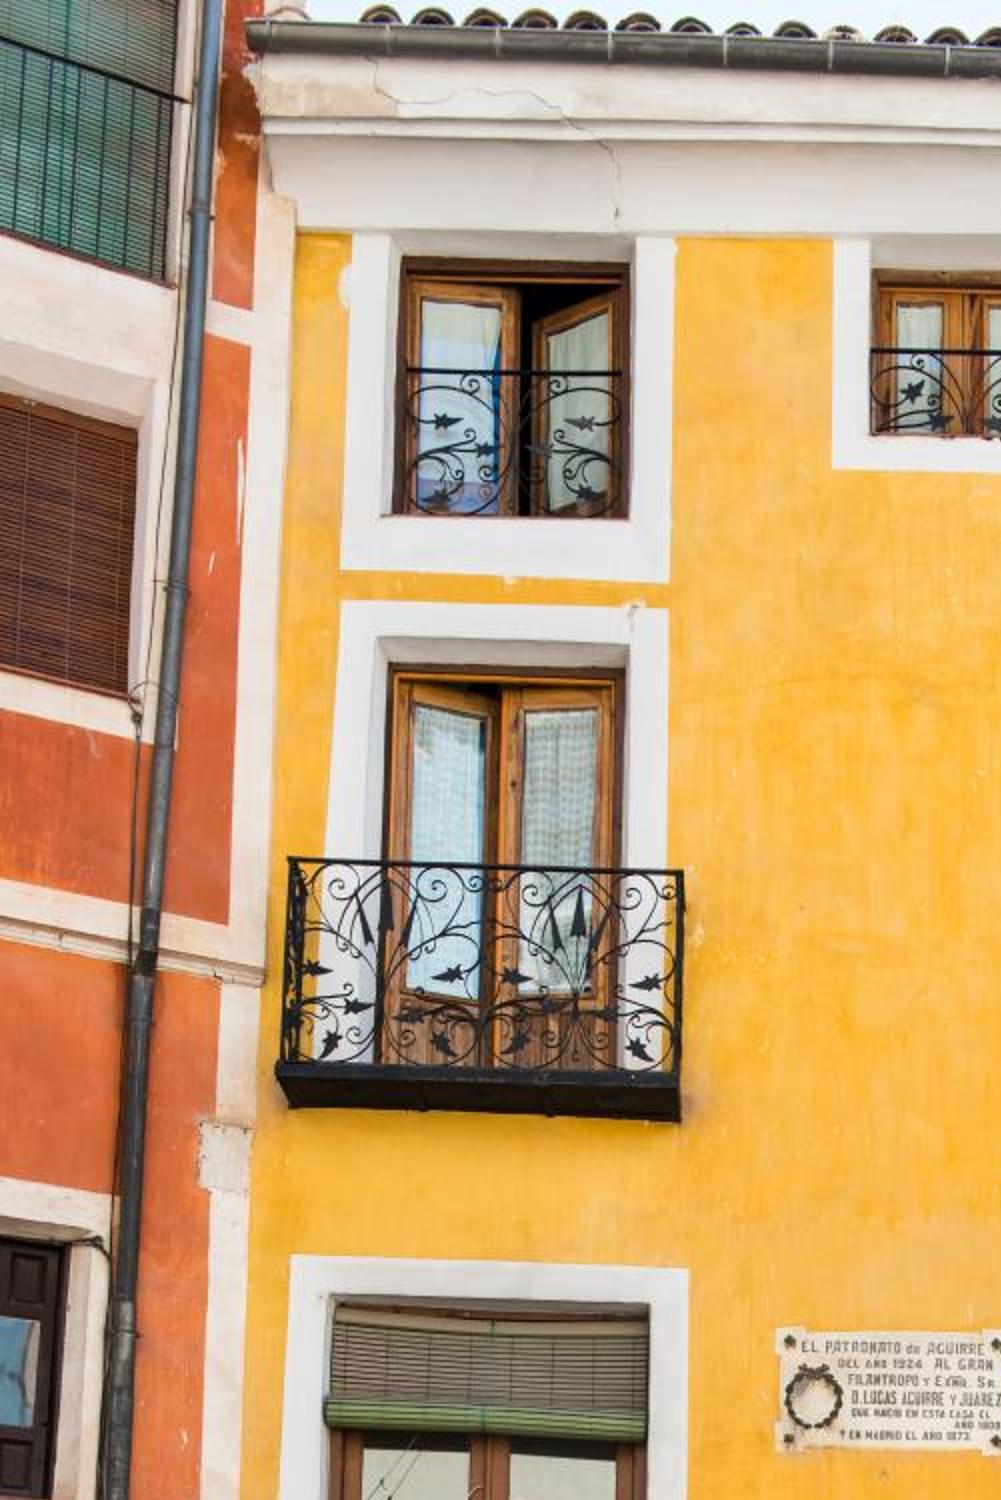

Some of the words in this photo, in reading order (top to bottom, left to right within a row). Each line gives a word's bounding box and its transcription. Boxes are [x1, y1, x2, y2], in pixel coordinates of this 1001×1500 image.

[801, 1340, 817, 1353] EL
[825, 1340, 901, 1354] PATRONATO
[926, 1341, 985, 1356] AGUIRRE
[934, 1358, 951, 1370] AL
[958, 1358, 993, 1371] GRAN
[848, 1373, 919, 1386] FILANTROPO
[902, 1391, 945, 1407] AGUIRRE
